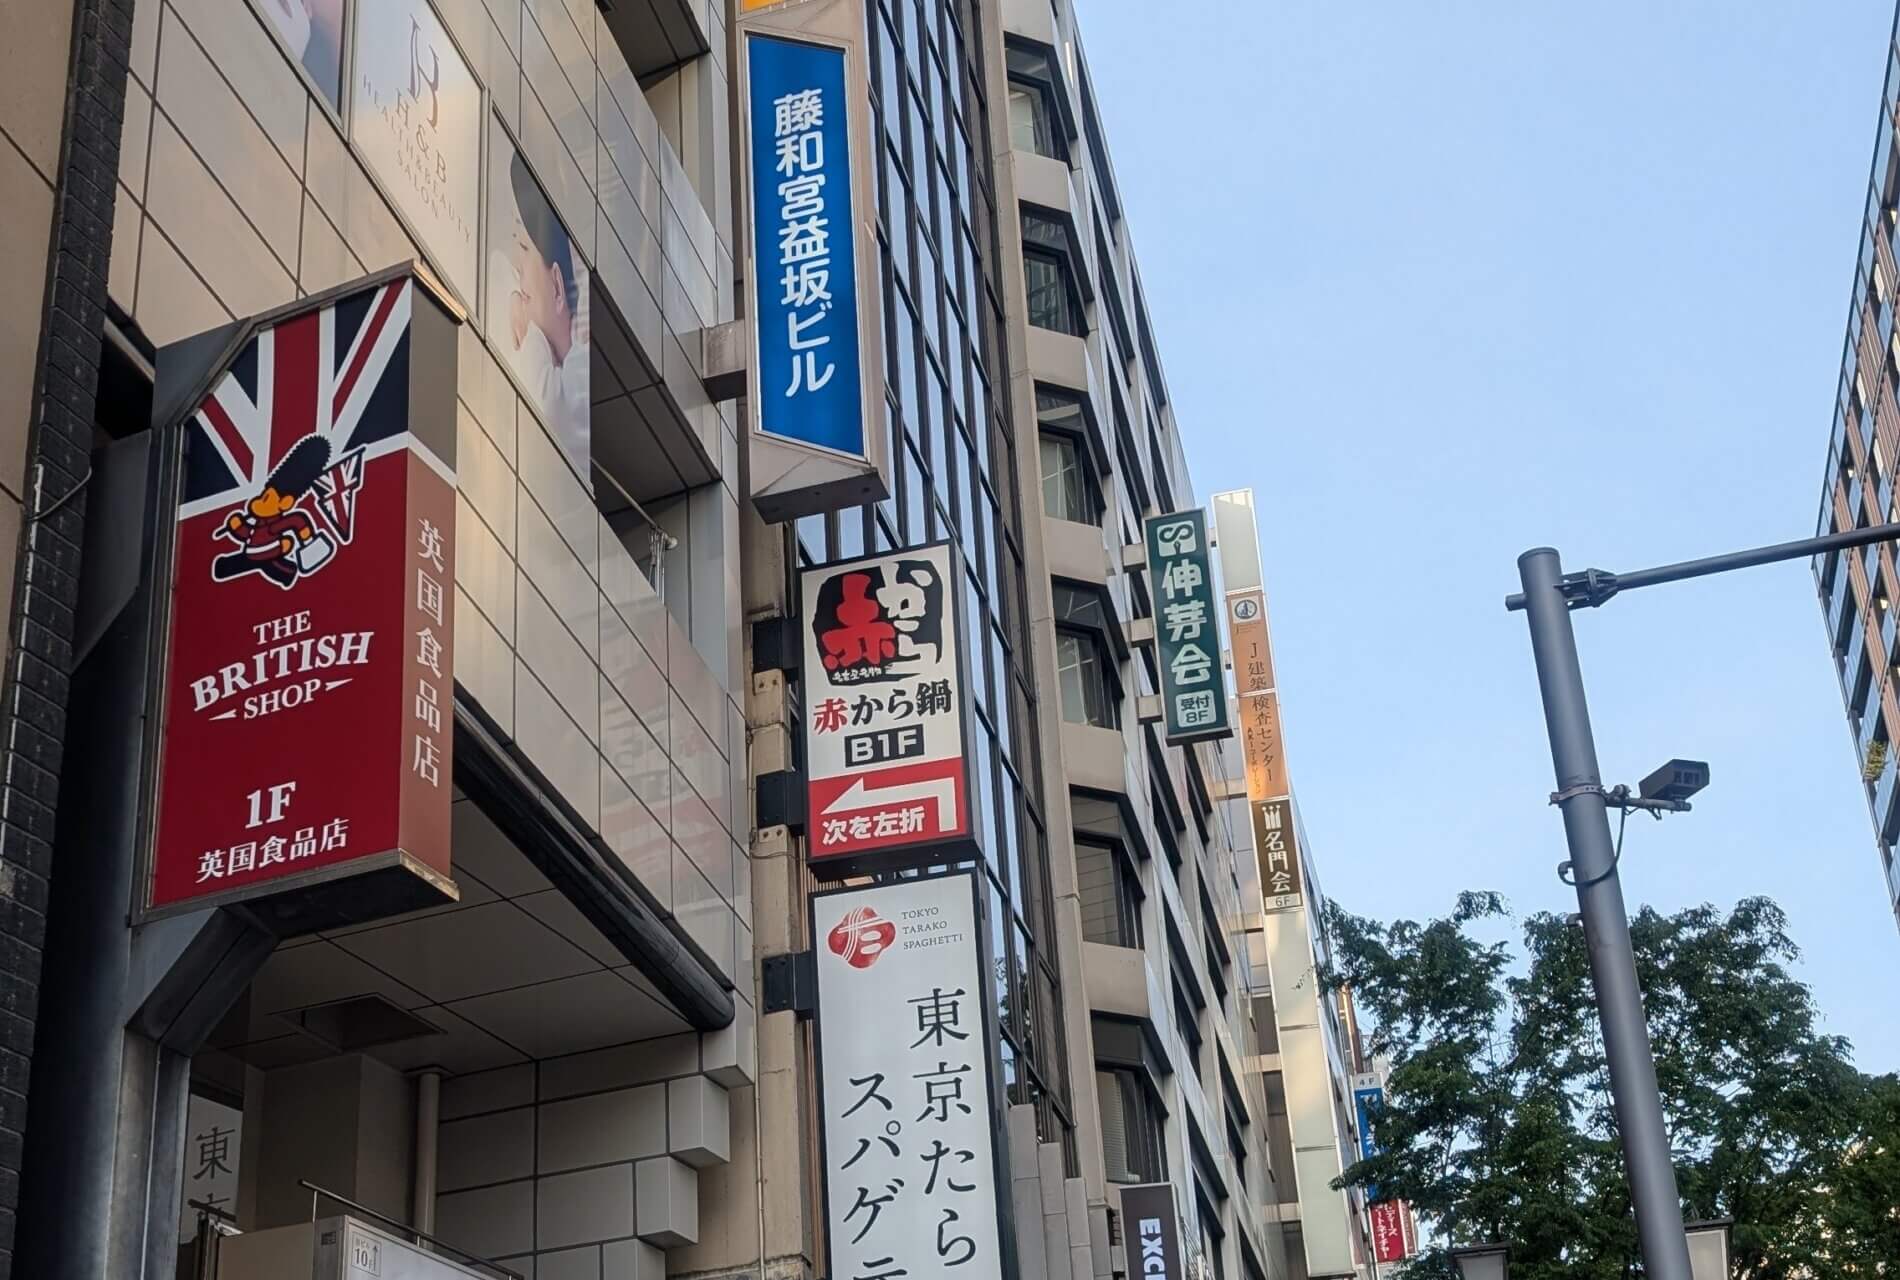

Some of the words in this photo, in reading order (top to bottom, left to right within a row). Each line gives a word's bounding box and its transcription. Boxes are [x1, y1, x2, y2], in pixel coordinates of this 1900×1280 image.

[397, 150, 439, 219] SALON
[773, 88, 835, 398] 藤和宮益坂ビル
[253, 610, 312, 646] THE
[1161, 559, 1212, 688] 伸芽会
[191, 630, 374, 712] BRITISH
[411, 516, 446, 788] 英国食品店
[243, 678, 321, 720] SHOP
[812, 678, 953, 736] 赤から鍋
[1180, 693, 1210, 712] 受付
[1186, 709, 1209, 724] 8F
[850, 728, 919, 763] B1F
[246, 780, 296, 829] 1F
[822, 806, 926, 847] 次を左折
[195, 817, 350, 883] 英国食品店
[1263, 830, 1292, 893] 名門会
[901, 906, 939, 920] TOKYO
[903, 920, 948, 935] TARAKO
[903, 933, 964, 950] SPAGHETTI
